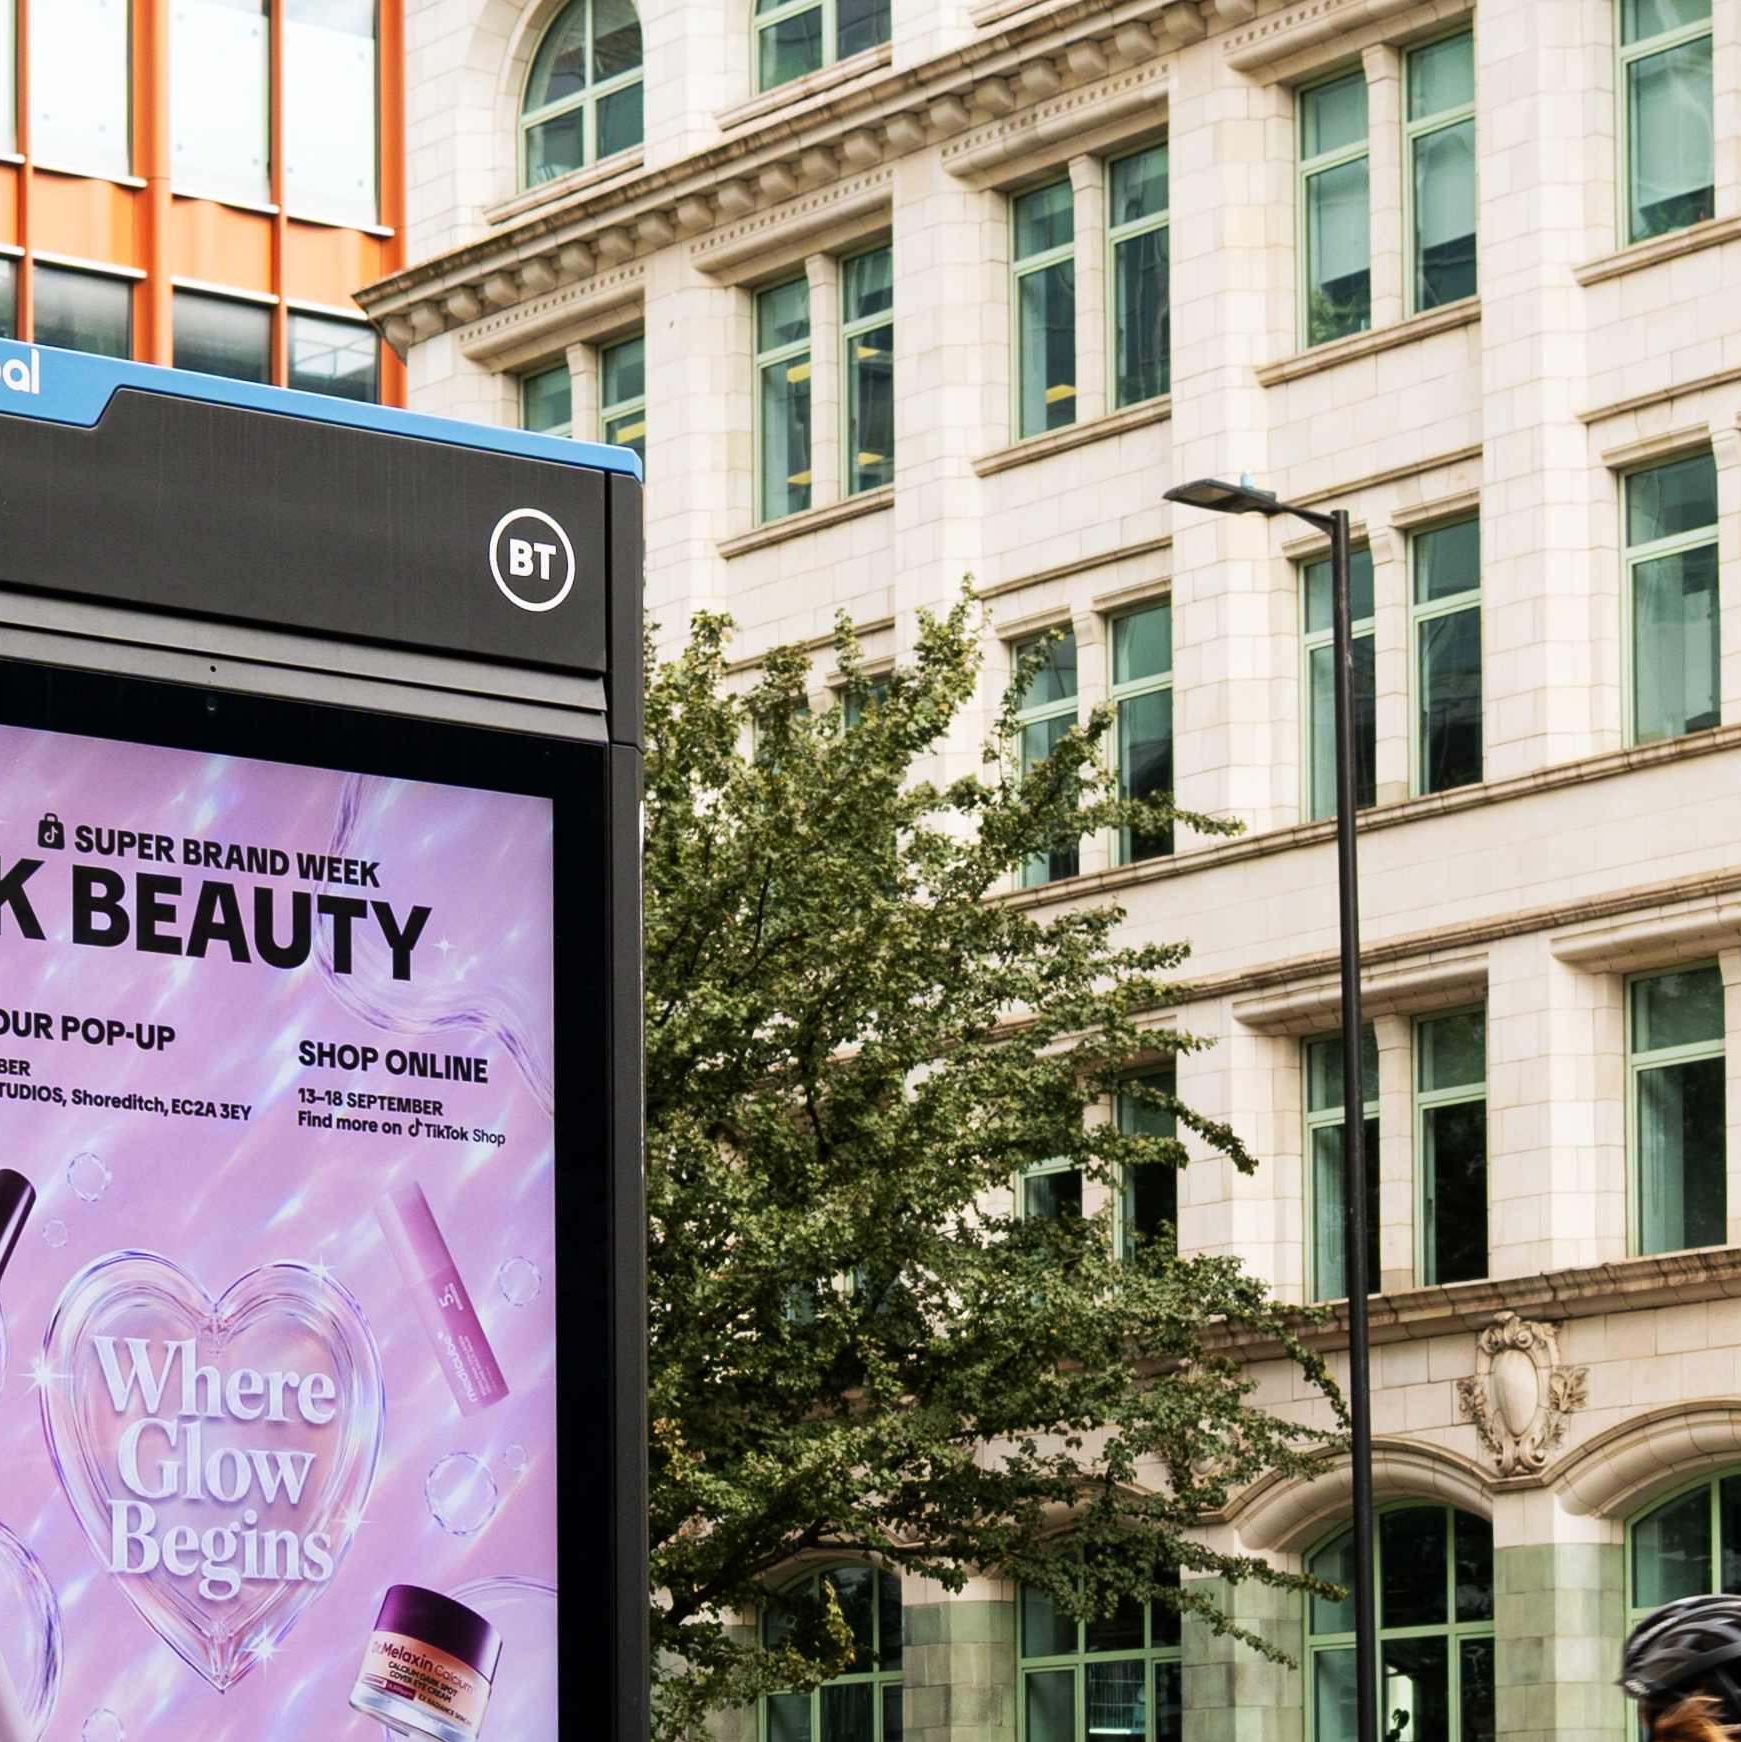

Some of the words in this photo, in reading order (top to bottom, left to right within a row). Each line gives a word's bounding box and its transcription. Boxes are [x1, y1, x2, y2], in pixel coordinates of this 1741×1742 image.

[508, 538, 557, 581] BT
[75, 825, 175, 863] SUPER
[183, 839, 289, 876] BRAND
[296, 852, 380, 888] WEEK
[73, 865, 432, 981] BEAUTY
[62, 1016, 175, 1051] POP-UP
[299, 1040, 378, 1071] SHOP
[385, 1049, 488, 1083] ONLINE
[71, 1089, 168, 1117] Shoreditch,
[172, 1099, 217, 1118] EC2A
[220, 1103, 251, 1120] 3EY
[347, 1092, 443, 1116] SEPTEMBER
[298, 1110, 332, 1128] Find
[337, 1118, 378, 1132] more
[382, 1122, 402, 1135] on
[424, 1123, 468, 1141] TikTok
[473, 1129, 505, 1147] Shop
[94, 1336, 336, 1424] Where
[118, 1418, 317, 1505] Glow
[108, 1498, 334, 1601] Begins
